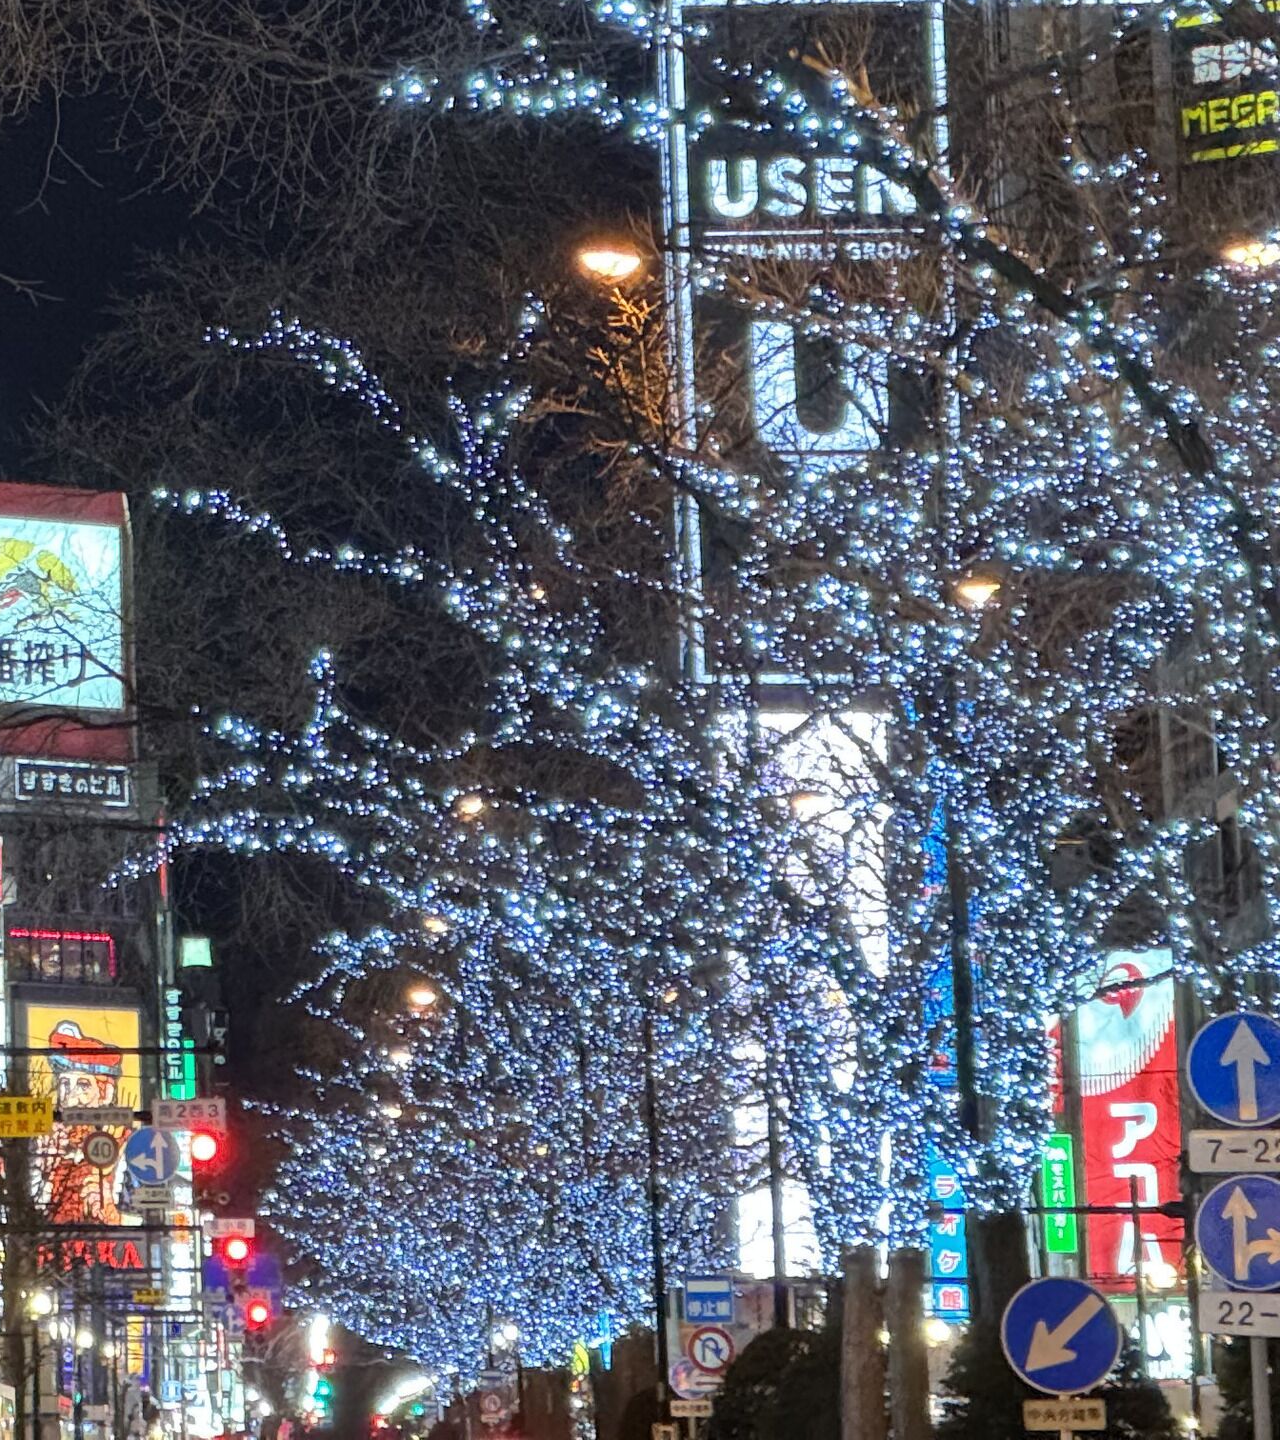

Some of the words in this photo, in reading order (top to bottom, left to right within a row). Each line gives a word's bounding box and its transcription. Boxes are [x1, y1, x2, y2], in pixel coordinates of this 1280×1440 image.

[1181, 90, 1280, 137] MEGA
[708, 157, 918, 218] USEN
[22, 770, 121, 796] すすきのビル
[92, 1141, 112, 1158] 40
